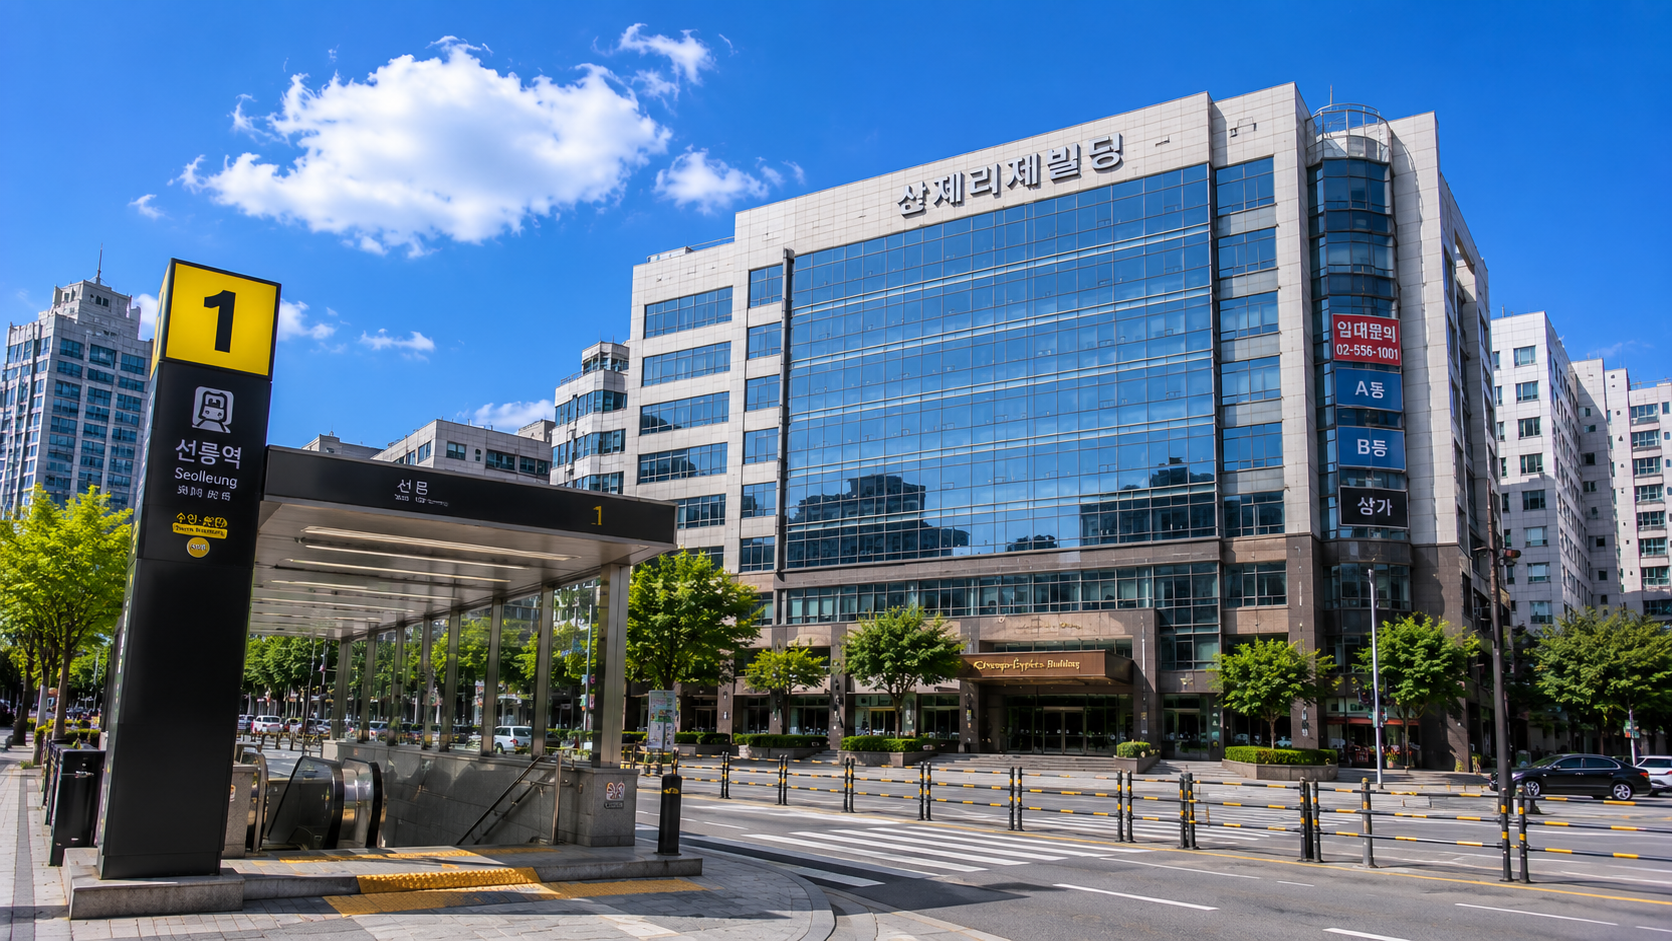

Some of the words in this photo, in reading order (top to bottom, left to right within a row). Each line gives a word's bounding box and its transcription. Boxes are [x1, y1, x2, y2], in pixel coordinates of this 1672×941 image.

[203, 289, 236, 354] 1
[1336, 344, 1399, 360] 02-556-1001
[175, 439, 242, 470] 선릉역
[174, 467, 238, 490] Seolleung
[592, 505, 603, 526] 1
[1357, 497, 1392, 516] 상가
